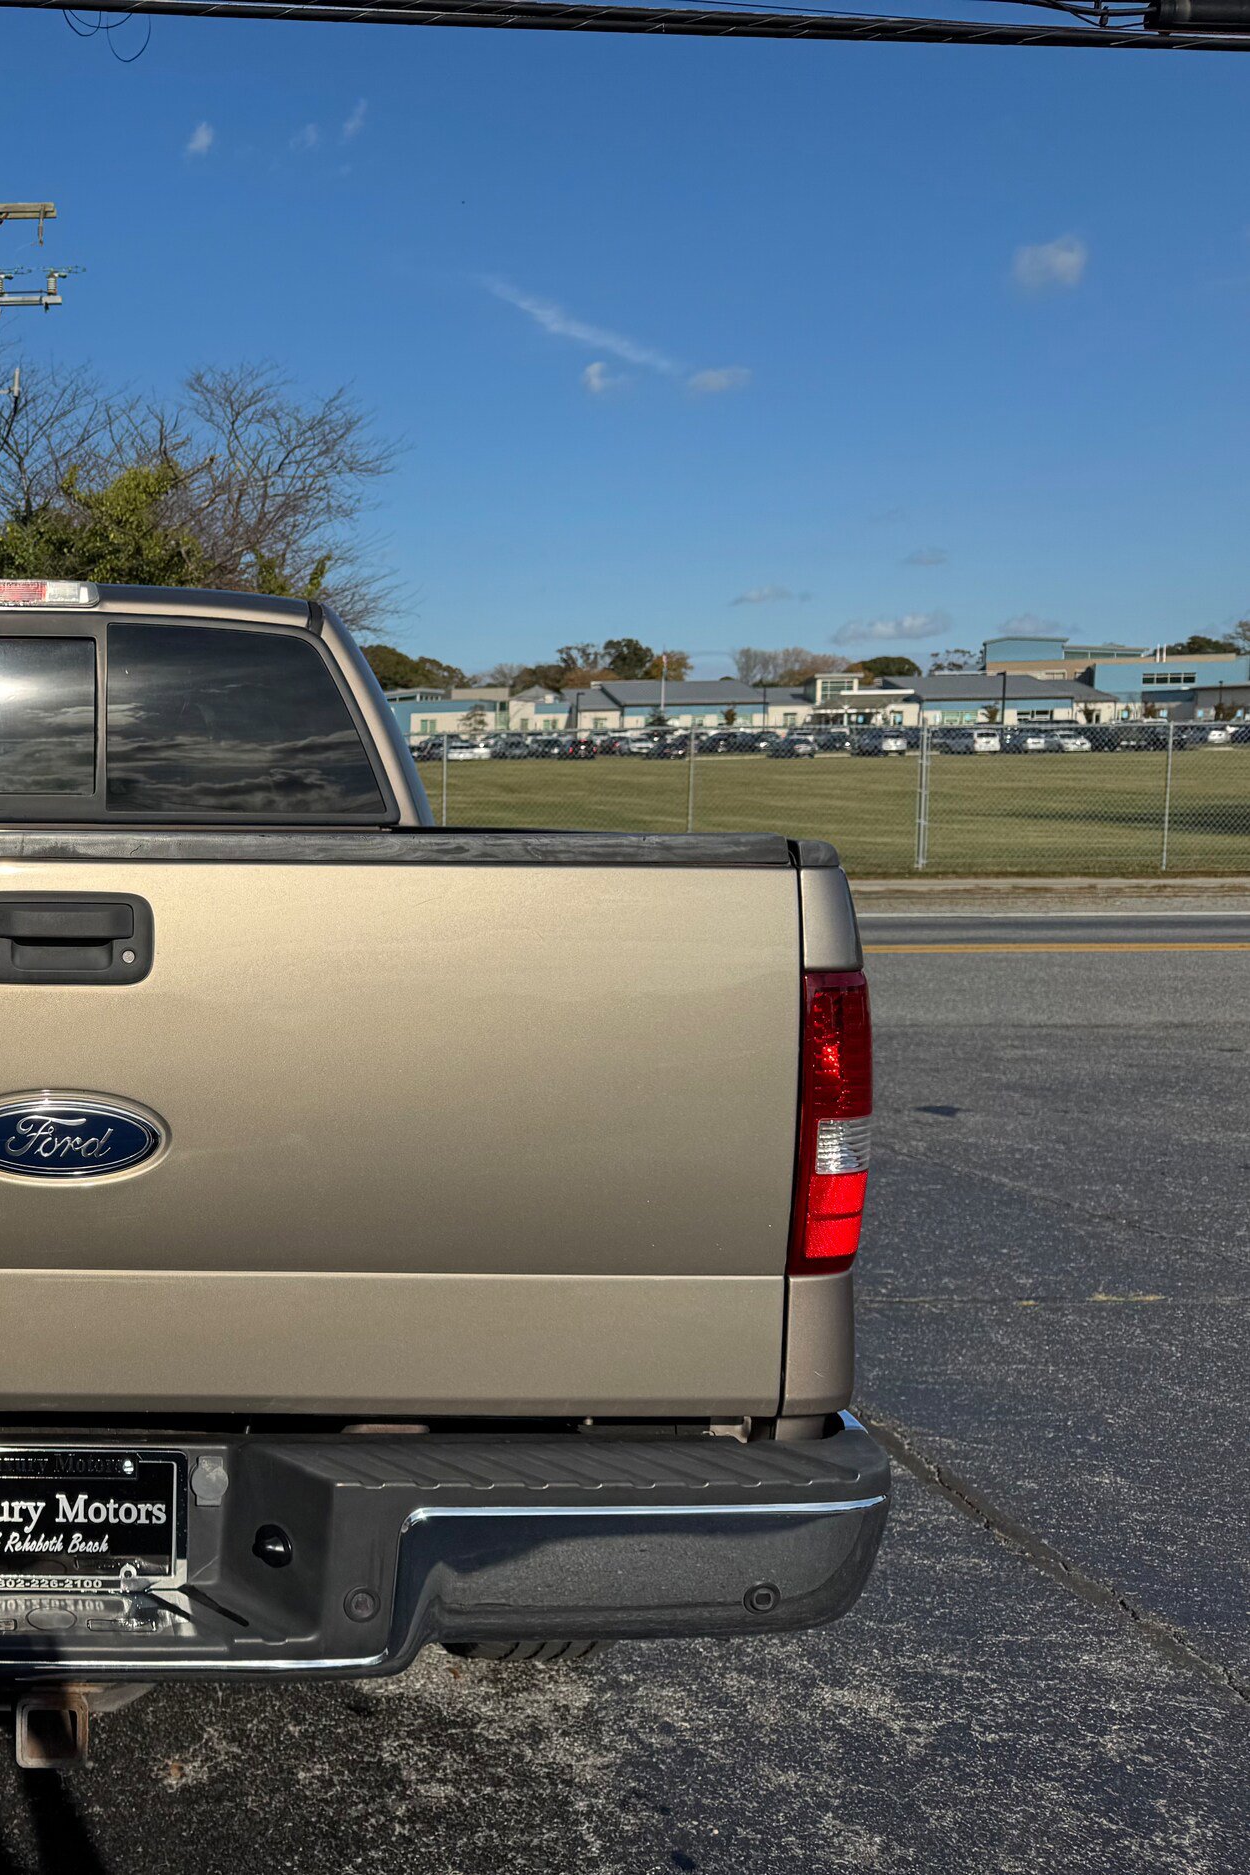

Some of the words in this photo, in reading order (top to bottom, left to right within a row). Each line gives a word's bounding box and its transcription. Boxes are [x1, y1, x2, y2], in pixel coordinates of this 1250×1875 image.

[5, 1114, 114, 1159] Ford
[55, 1492, 167, 1524] Motors
[4, 1532, 64, 1553] Rehoboth
[67, 1533, 109, 1554] Beach
